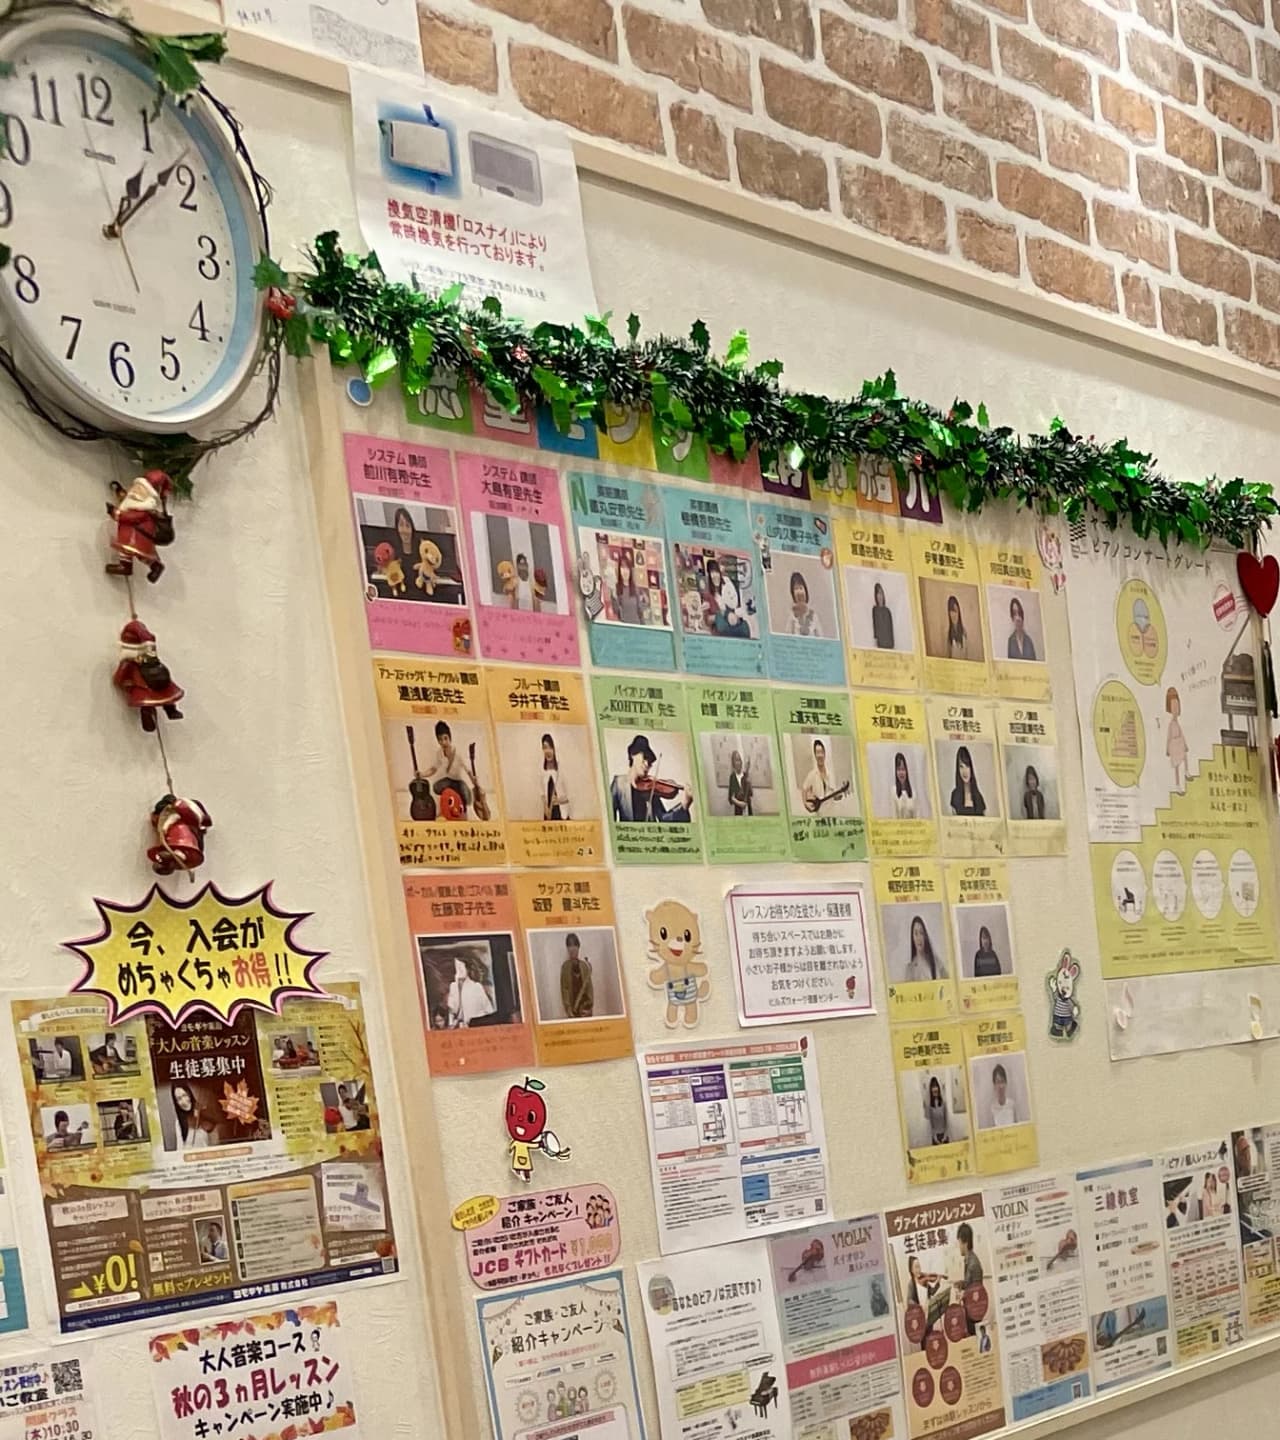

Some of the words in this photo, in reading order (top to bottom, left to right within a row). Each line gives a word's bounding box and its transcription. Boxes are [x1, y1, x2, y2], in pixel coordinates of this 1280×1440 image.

[30, 72, 66, 127] 11
[76, 72, 115, 127] 12
[140, 109, 154, 153] 1
[176, 164, 199, 212] 2
[198, 235, 221, 281] 3
[388, 220, 546, 273] 常時換気を行っております。
[13, 254, 40, 304] 8
[60, 315, 83, 361] 7
[189, 300, 211, 343] 4
[110, 342, 135, 389] 6
[160, 336, 181, 382] 5
[609, 699, 654, 715] KOHTEN
[126, 916, 266, 957] 今、入会が
[168, 1056, 246, 1081] 生徒募集中
[893, 1199, 977, 1232] ヴァイオリンレッスン
[991, 1199, 1030, 1220] VIOLIN
[904, 1228, 949, 1255] 生徒募集
[472, 1257, 510, 1278] JCB
[199, 1331, 307, 1375] 大人音楽コース
[510, 1322, 604, 1355] 紹介キャンペーン
